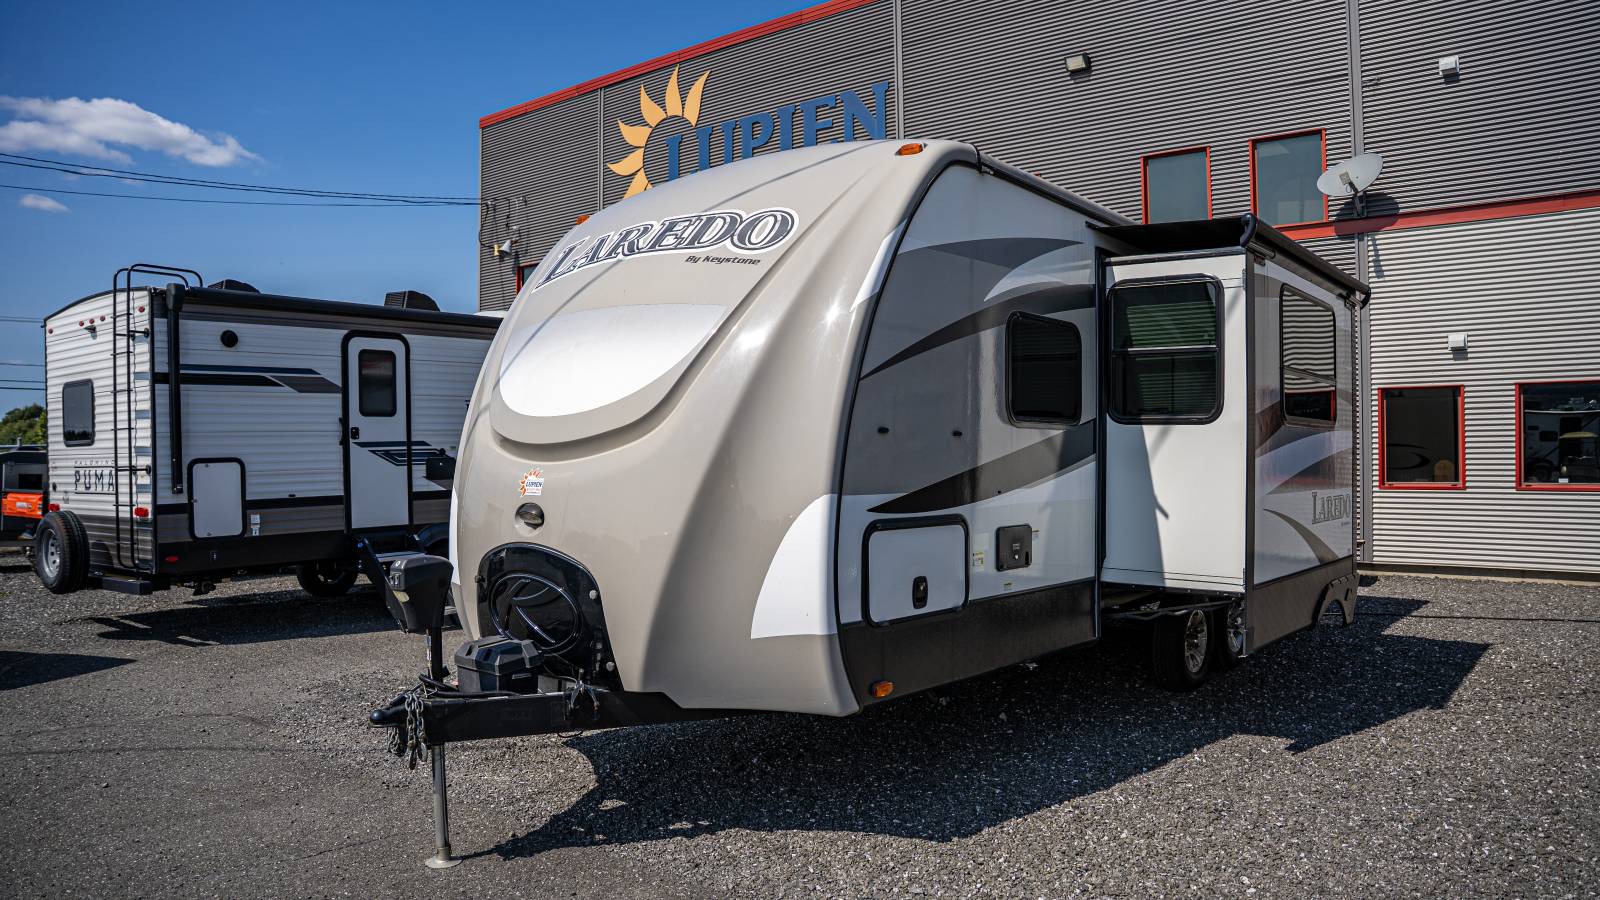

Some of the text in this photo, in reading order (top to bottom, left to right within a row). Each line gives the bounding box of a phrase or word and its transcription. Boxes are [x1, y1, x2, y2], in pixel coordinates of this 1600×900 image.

[533, 207, 797, 291] LAREDO
[685, 255, 761, 265] By Keystone
[74, 469, 115, 491] PUMA
[1312, 491, 1351, 524] LAREDO
